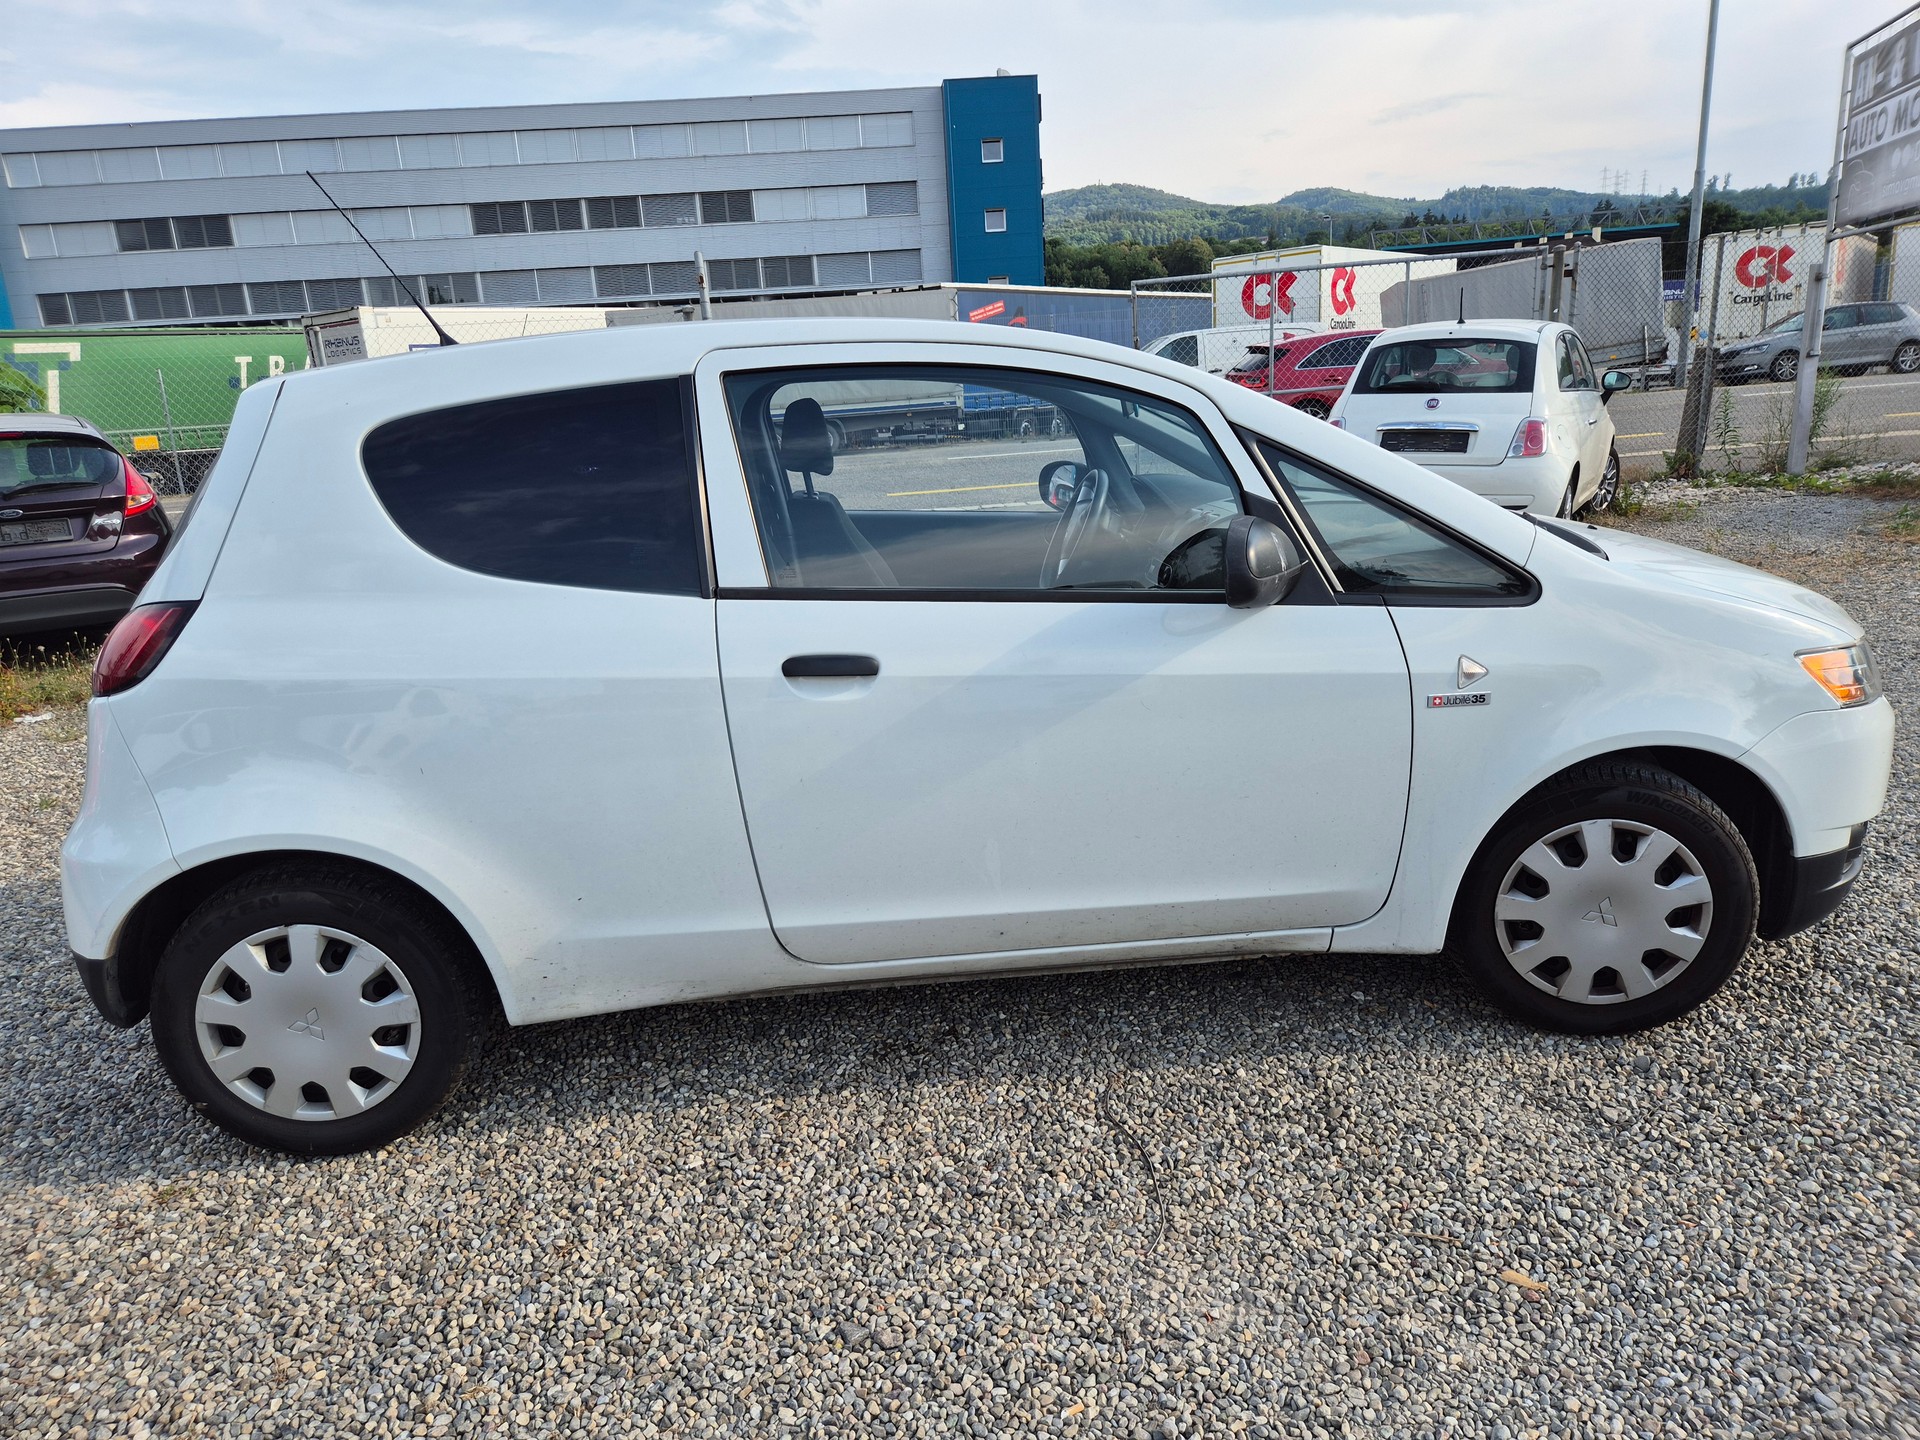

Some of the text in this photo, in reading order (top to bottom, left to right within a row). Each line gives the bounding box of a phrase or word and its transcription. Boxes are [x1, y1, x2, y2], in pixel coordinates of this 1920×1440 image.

[1848, 104, 1889, 154] AUTO
[1330, 317, 1357, 330] CargoLine
[324, 335, 360, 350] RHENUS
[326, 347, 362, 359] LOGISTICS
[1626, 790, 1716, 834] WINGUARD
